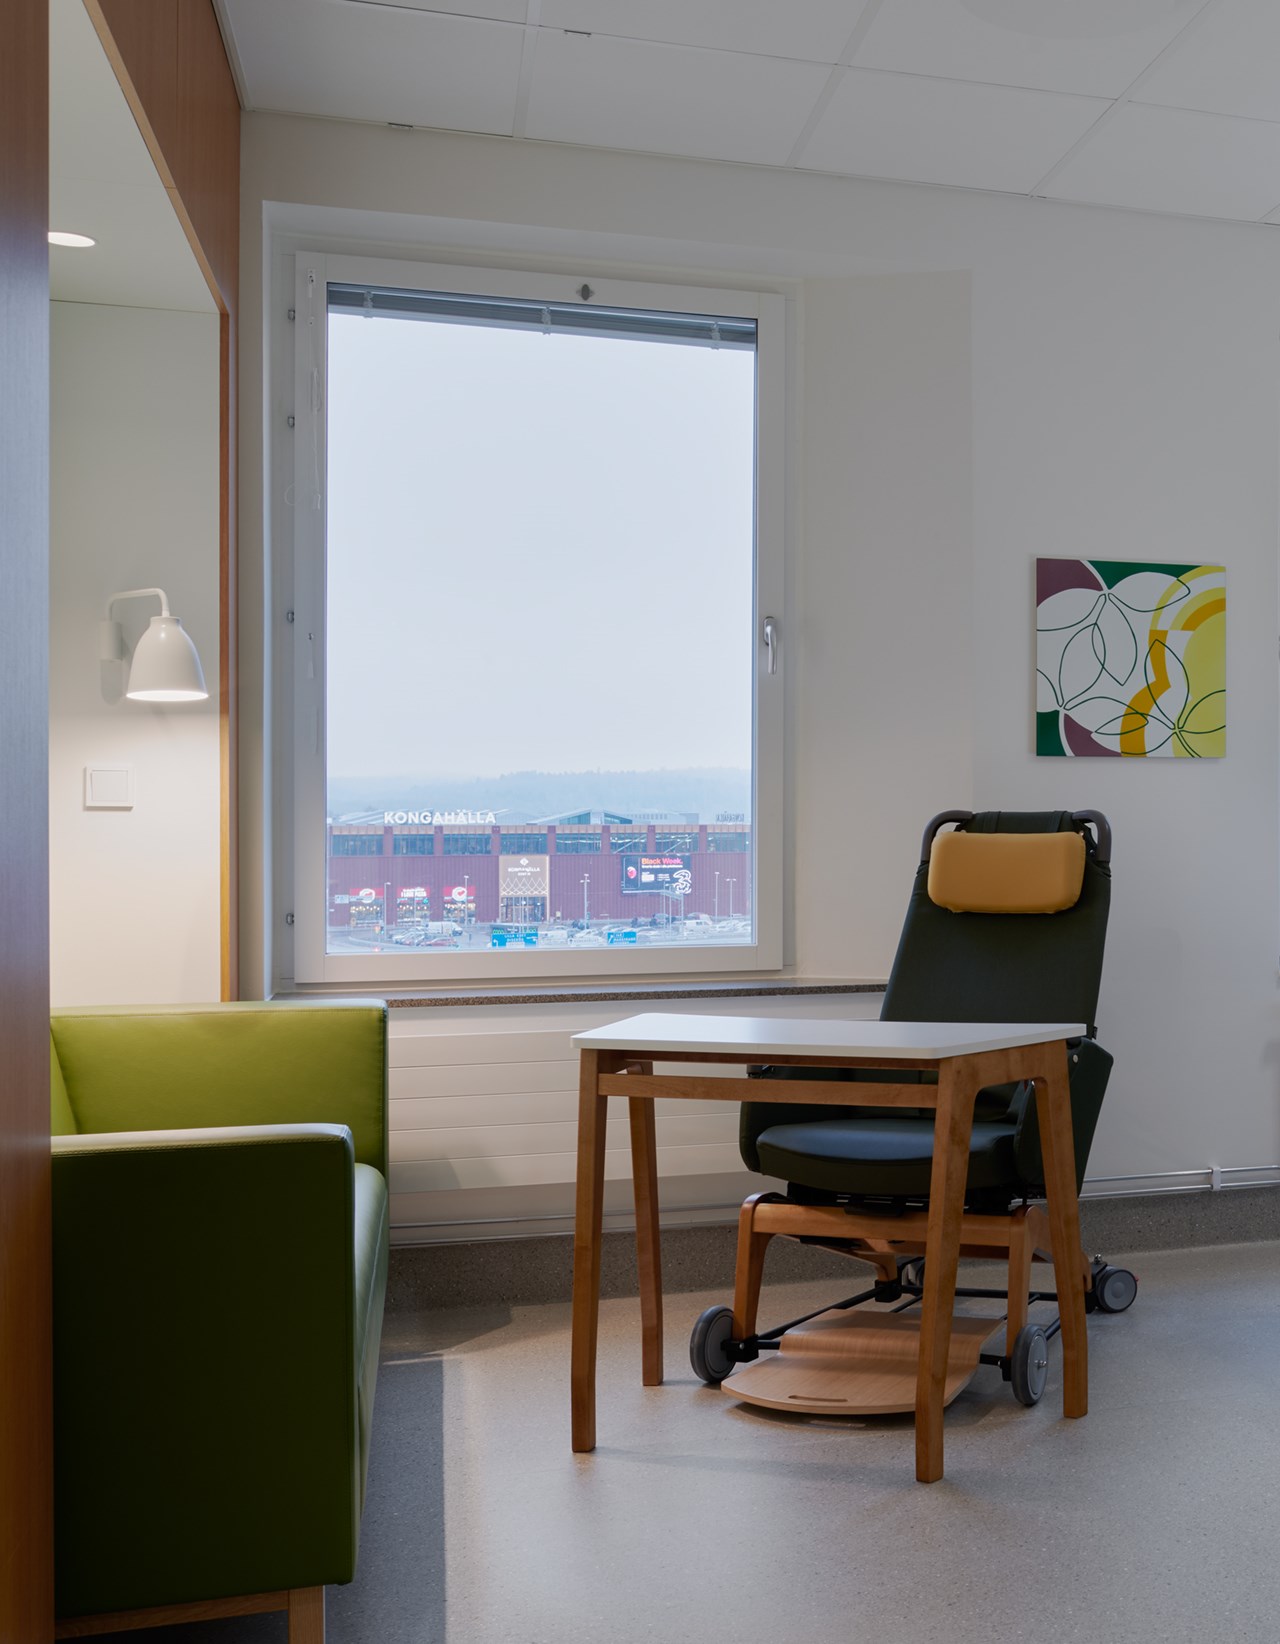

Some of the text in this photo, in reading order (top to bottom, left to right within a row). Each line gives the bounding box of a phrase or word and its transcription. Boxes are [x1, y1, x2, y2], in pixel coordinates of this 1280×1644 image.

[383, 809, 496, 824] KONGAHÄLLA
[641, 857, 683, 865] Black Week.
